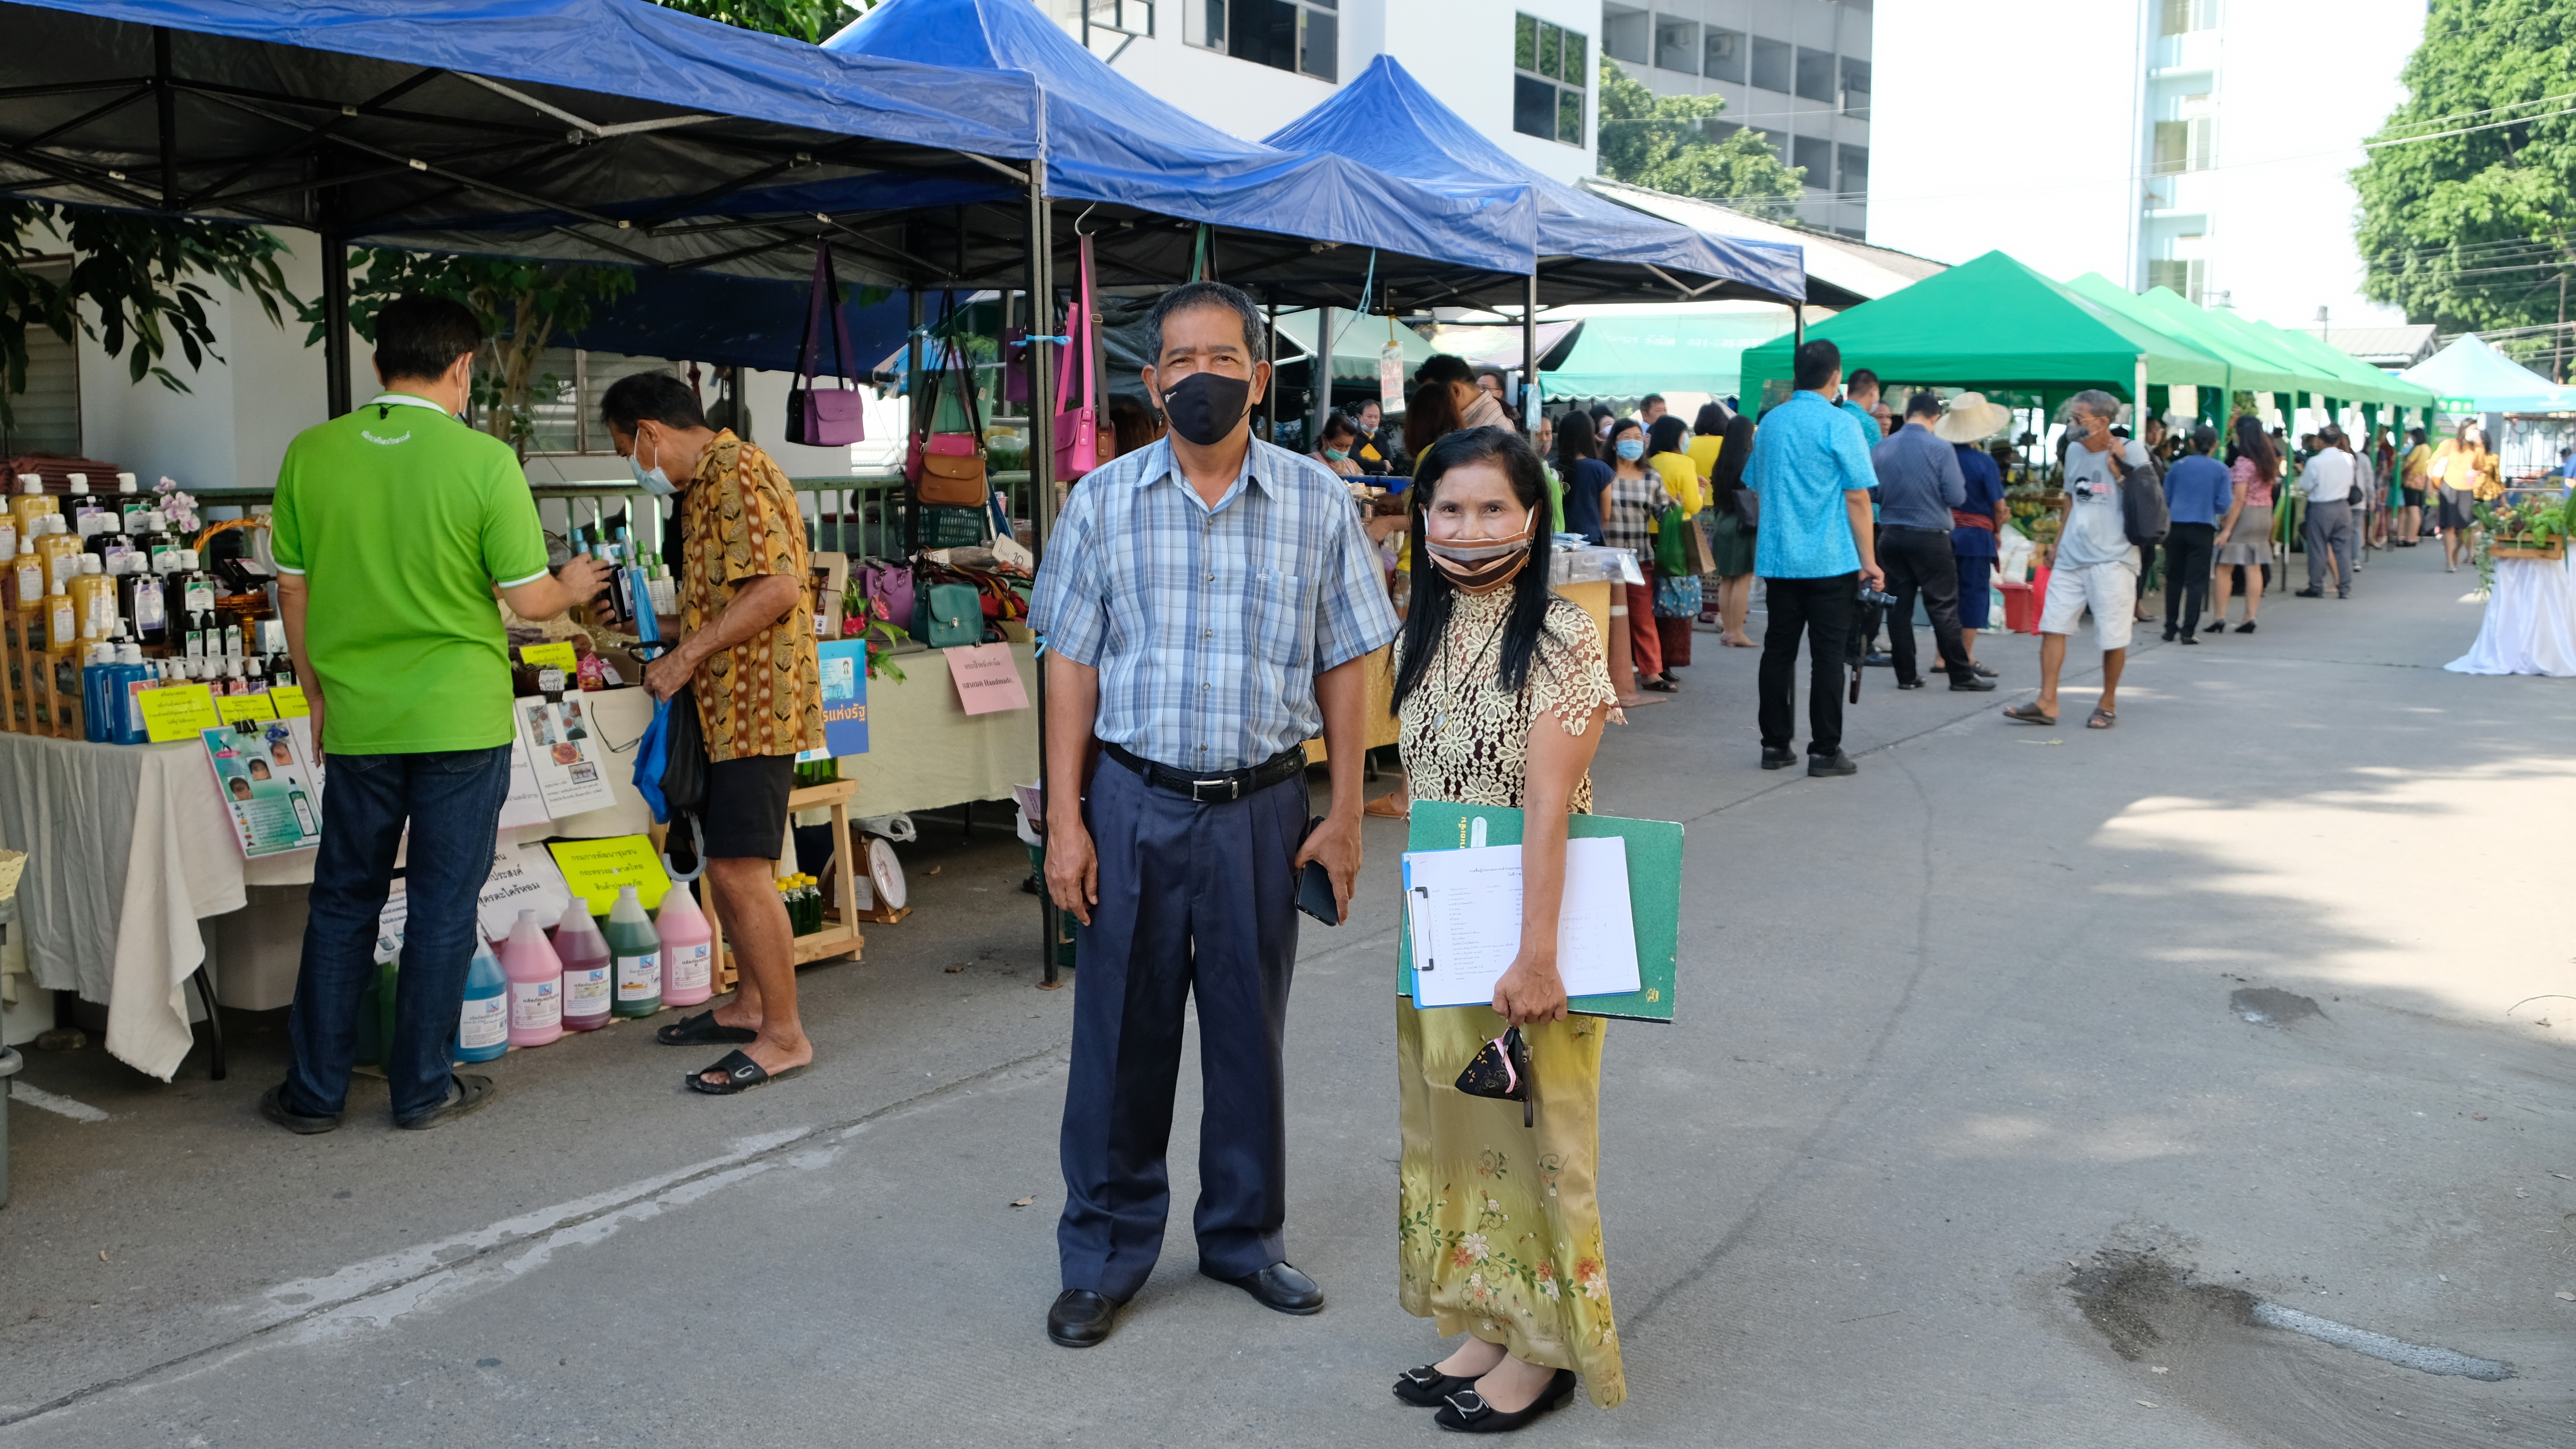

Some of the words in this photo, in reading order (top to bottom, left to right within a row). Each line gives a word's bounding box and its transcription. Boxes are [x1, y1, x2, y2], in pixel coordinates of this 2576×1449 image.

[984, 677, 1014, 687] Handmade.
[571, 849, 637, 861] กรมการพัฒนาชุมชน
[478, 882, 540, 907] สูตรตะไคร้หอม
